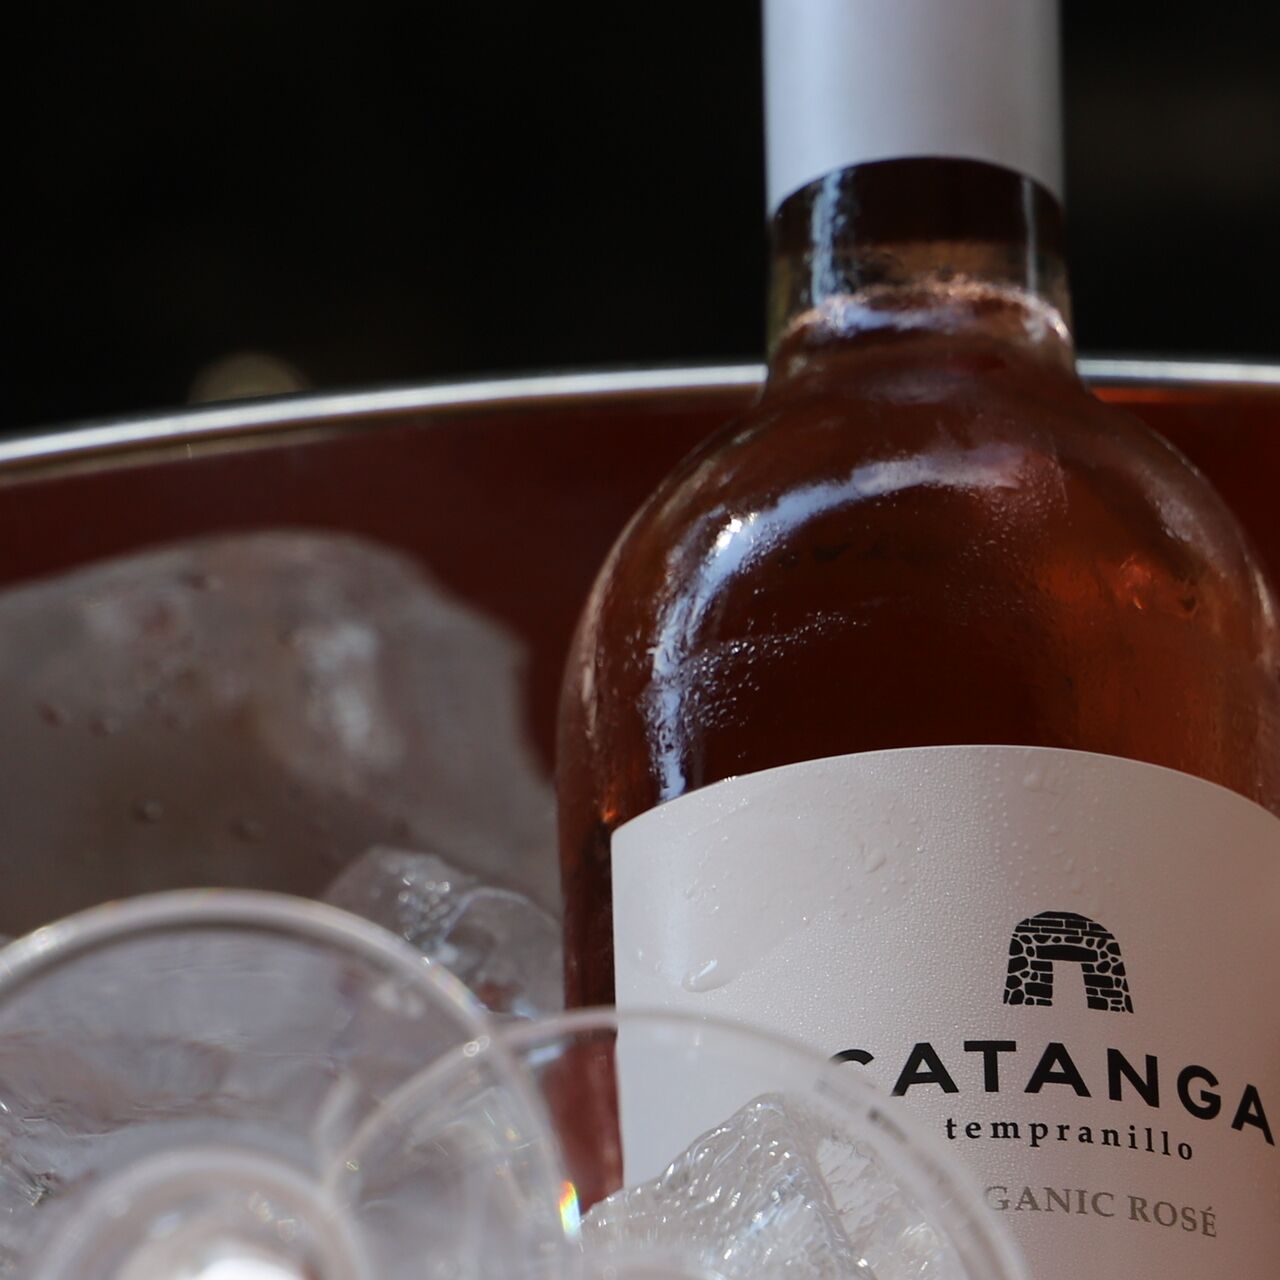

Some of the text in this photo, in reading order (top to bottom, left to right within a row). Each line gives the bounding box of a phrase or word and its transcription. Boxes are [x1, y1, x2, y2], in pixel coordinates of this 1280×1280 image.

[944, 1117, 1194, 1161] tempranillo
[983, 1184, 1218, 1239] GANIC ROSÉ
